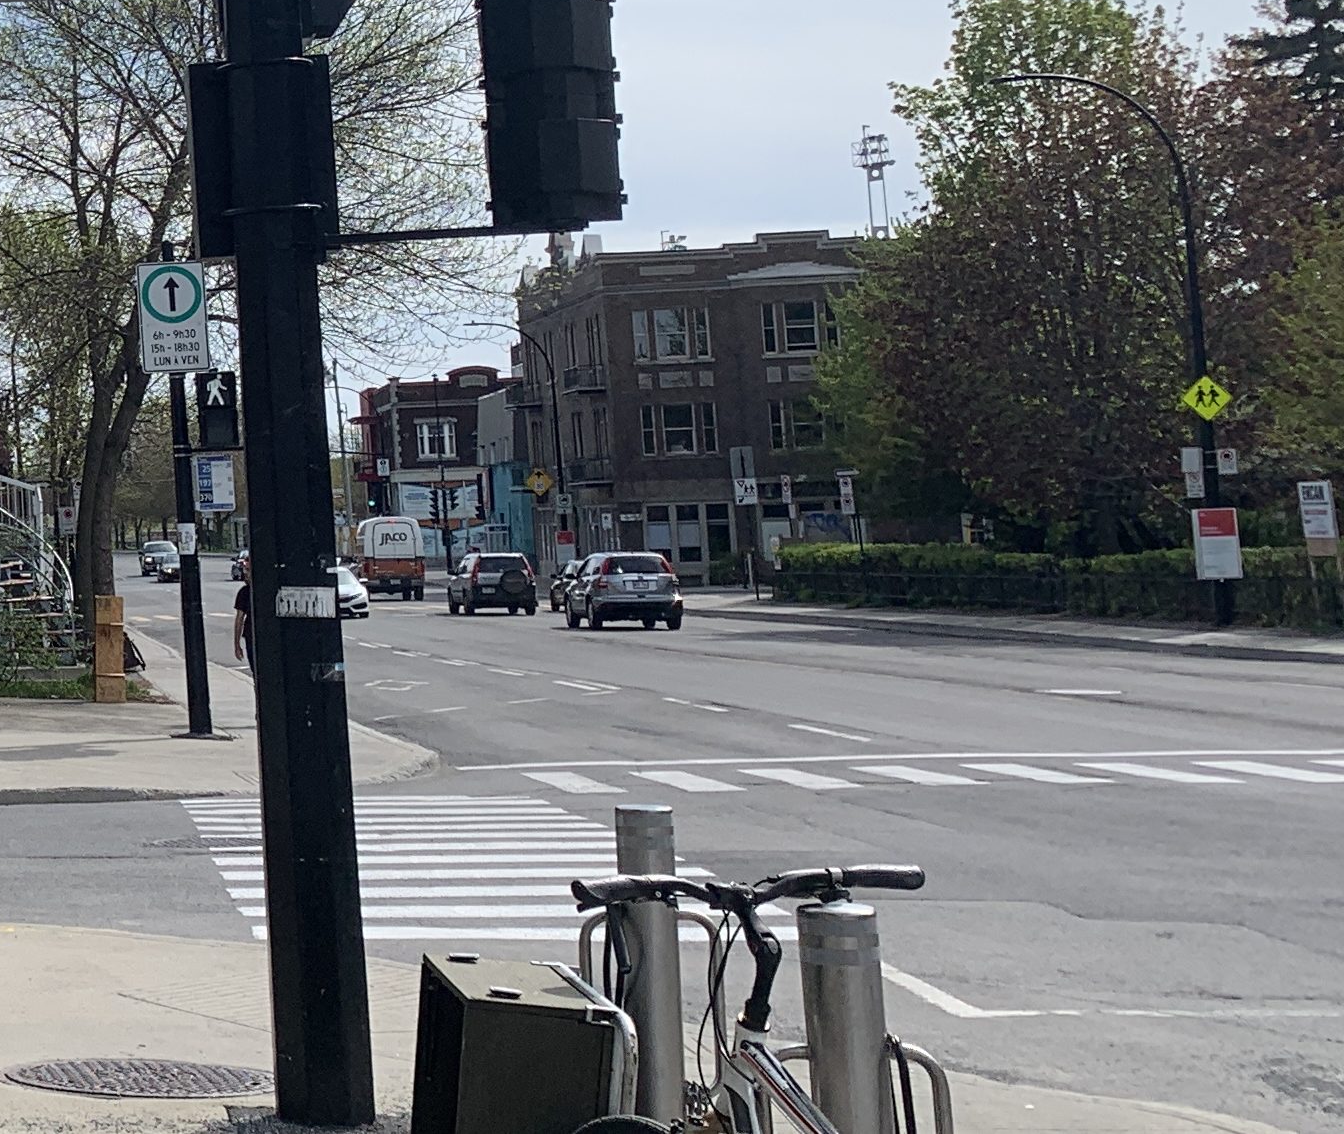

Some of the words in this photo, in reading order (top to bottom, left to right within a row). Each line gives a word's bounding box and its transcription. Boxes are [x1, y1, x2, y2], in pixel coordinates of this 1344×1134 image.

[153, 331, 164, 340] 6h
[173, 329, 196, 339] 9h30
[151, 343, 165, 353] 15h
[174, 341, 200, 352] 18h30
[154, 356, 171, 366] LUN
[181, 355, 199, 365] VEN
[202, 465, 211, 473] 25
[199, 478, 212, 487] 197
[379, 532, 407, 546] JACO
